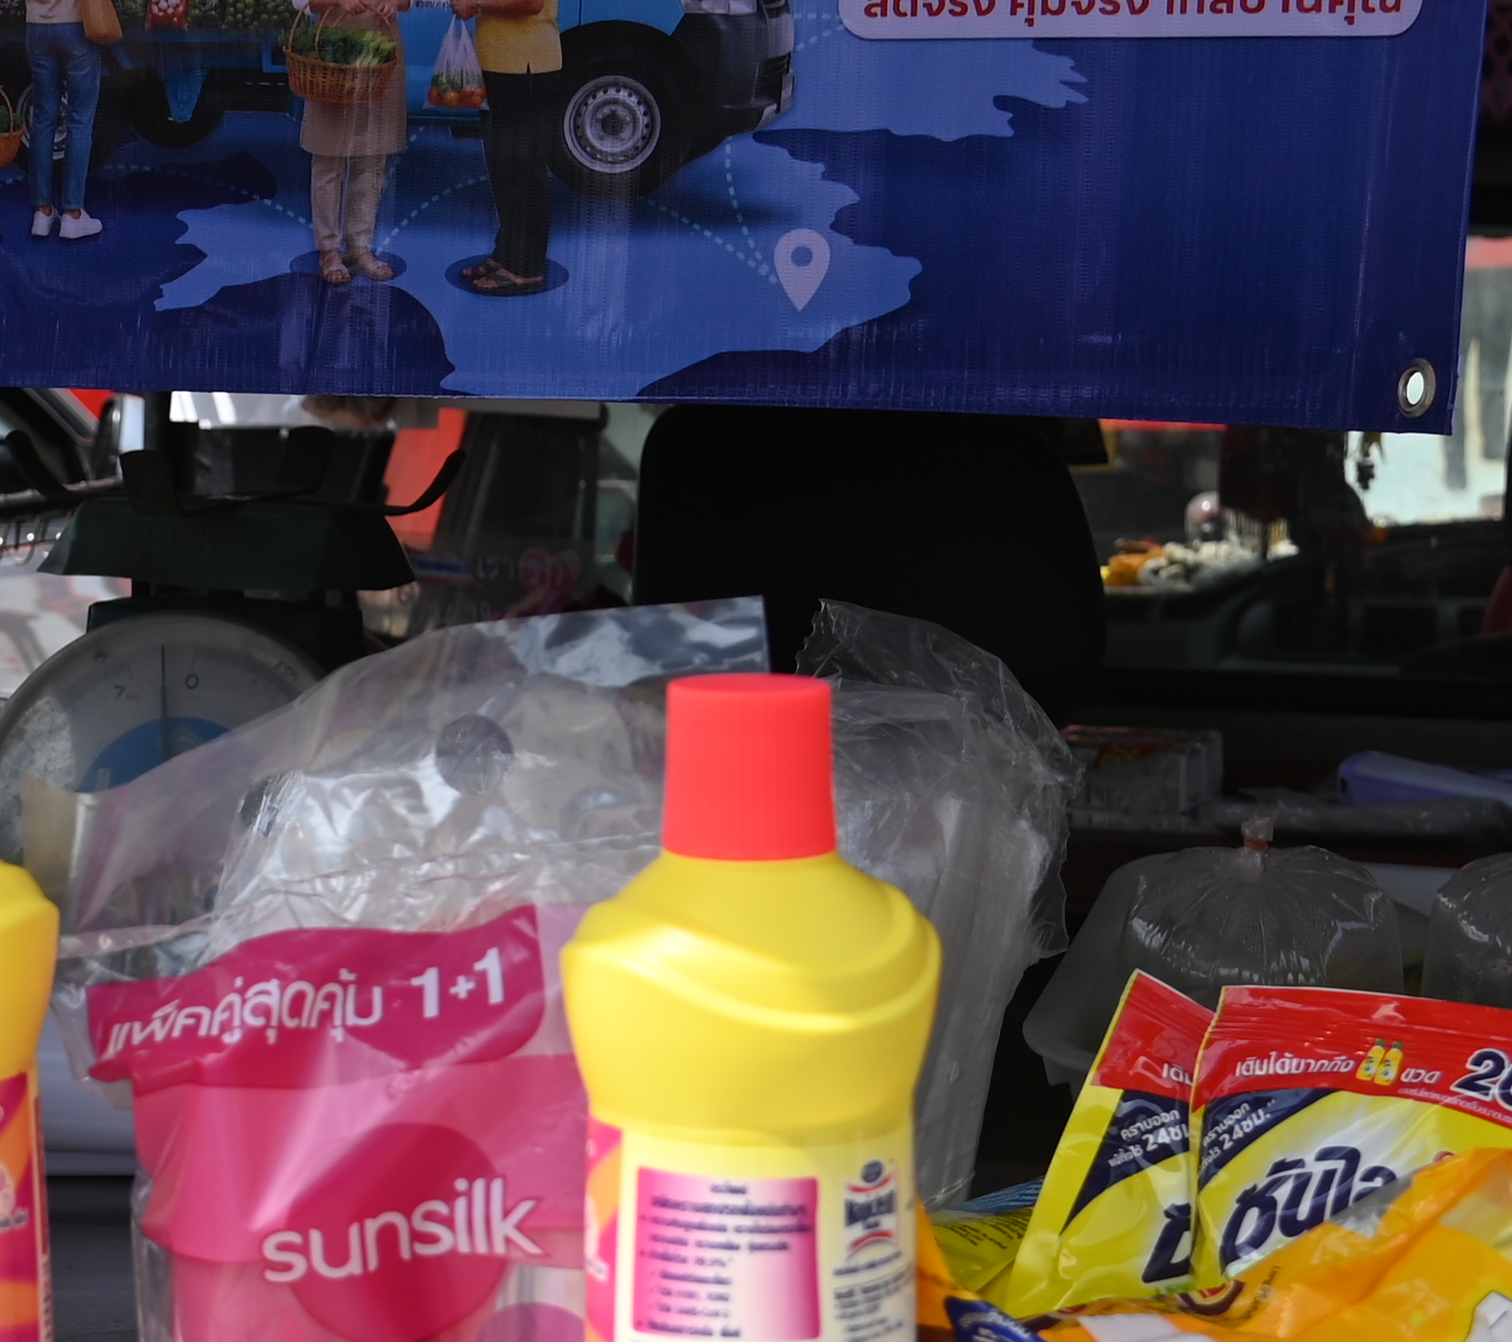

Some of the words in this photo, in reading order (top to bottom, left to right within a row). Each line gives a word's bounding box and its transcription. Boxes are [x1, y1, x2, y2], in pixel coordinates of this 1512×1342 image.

[108, 969, 381, 1055] แพ็คคู่สุดคุ้ม
[411, 948, 505, 1019] 1+1
[1236, 1052, 1355, 1077] เติมได้มากถึง
[1401, 1067, 1442, 1084] ขวด
[263, 1178, 543, 1283] sunsilk
